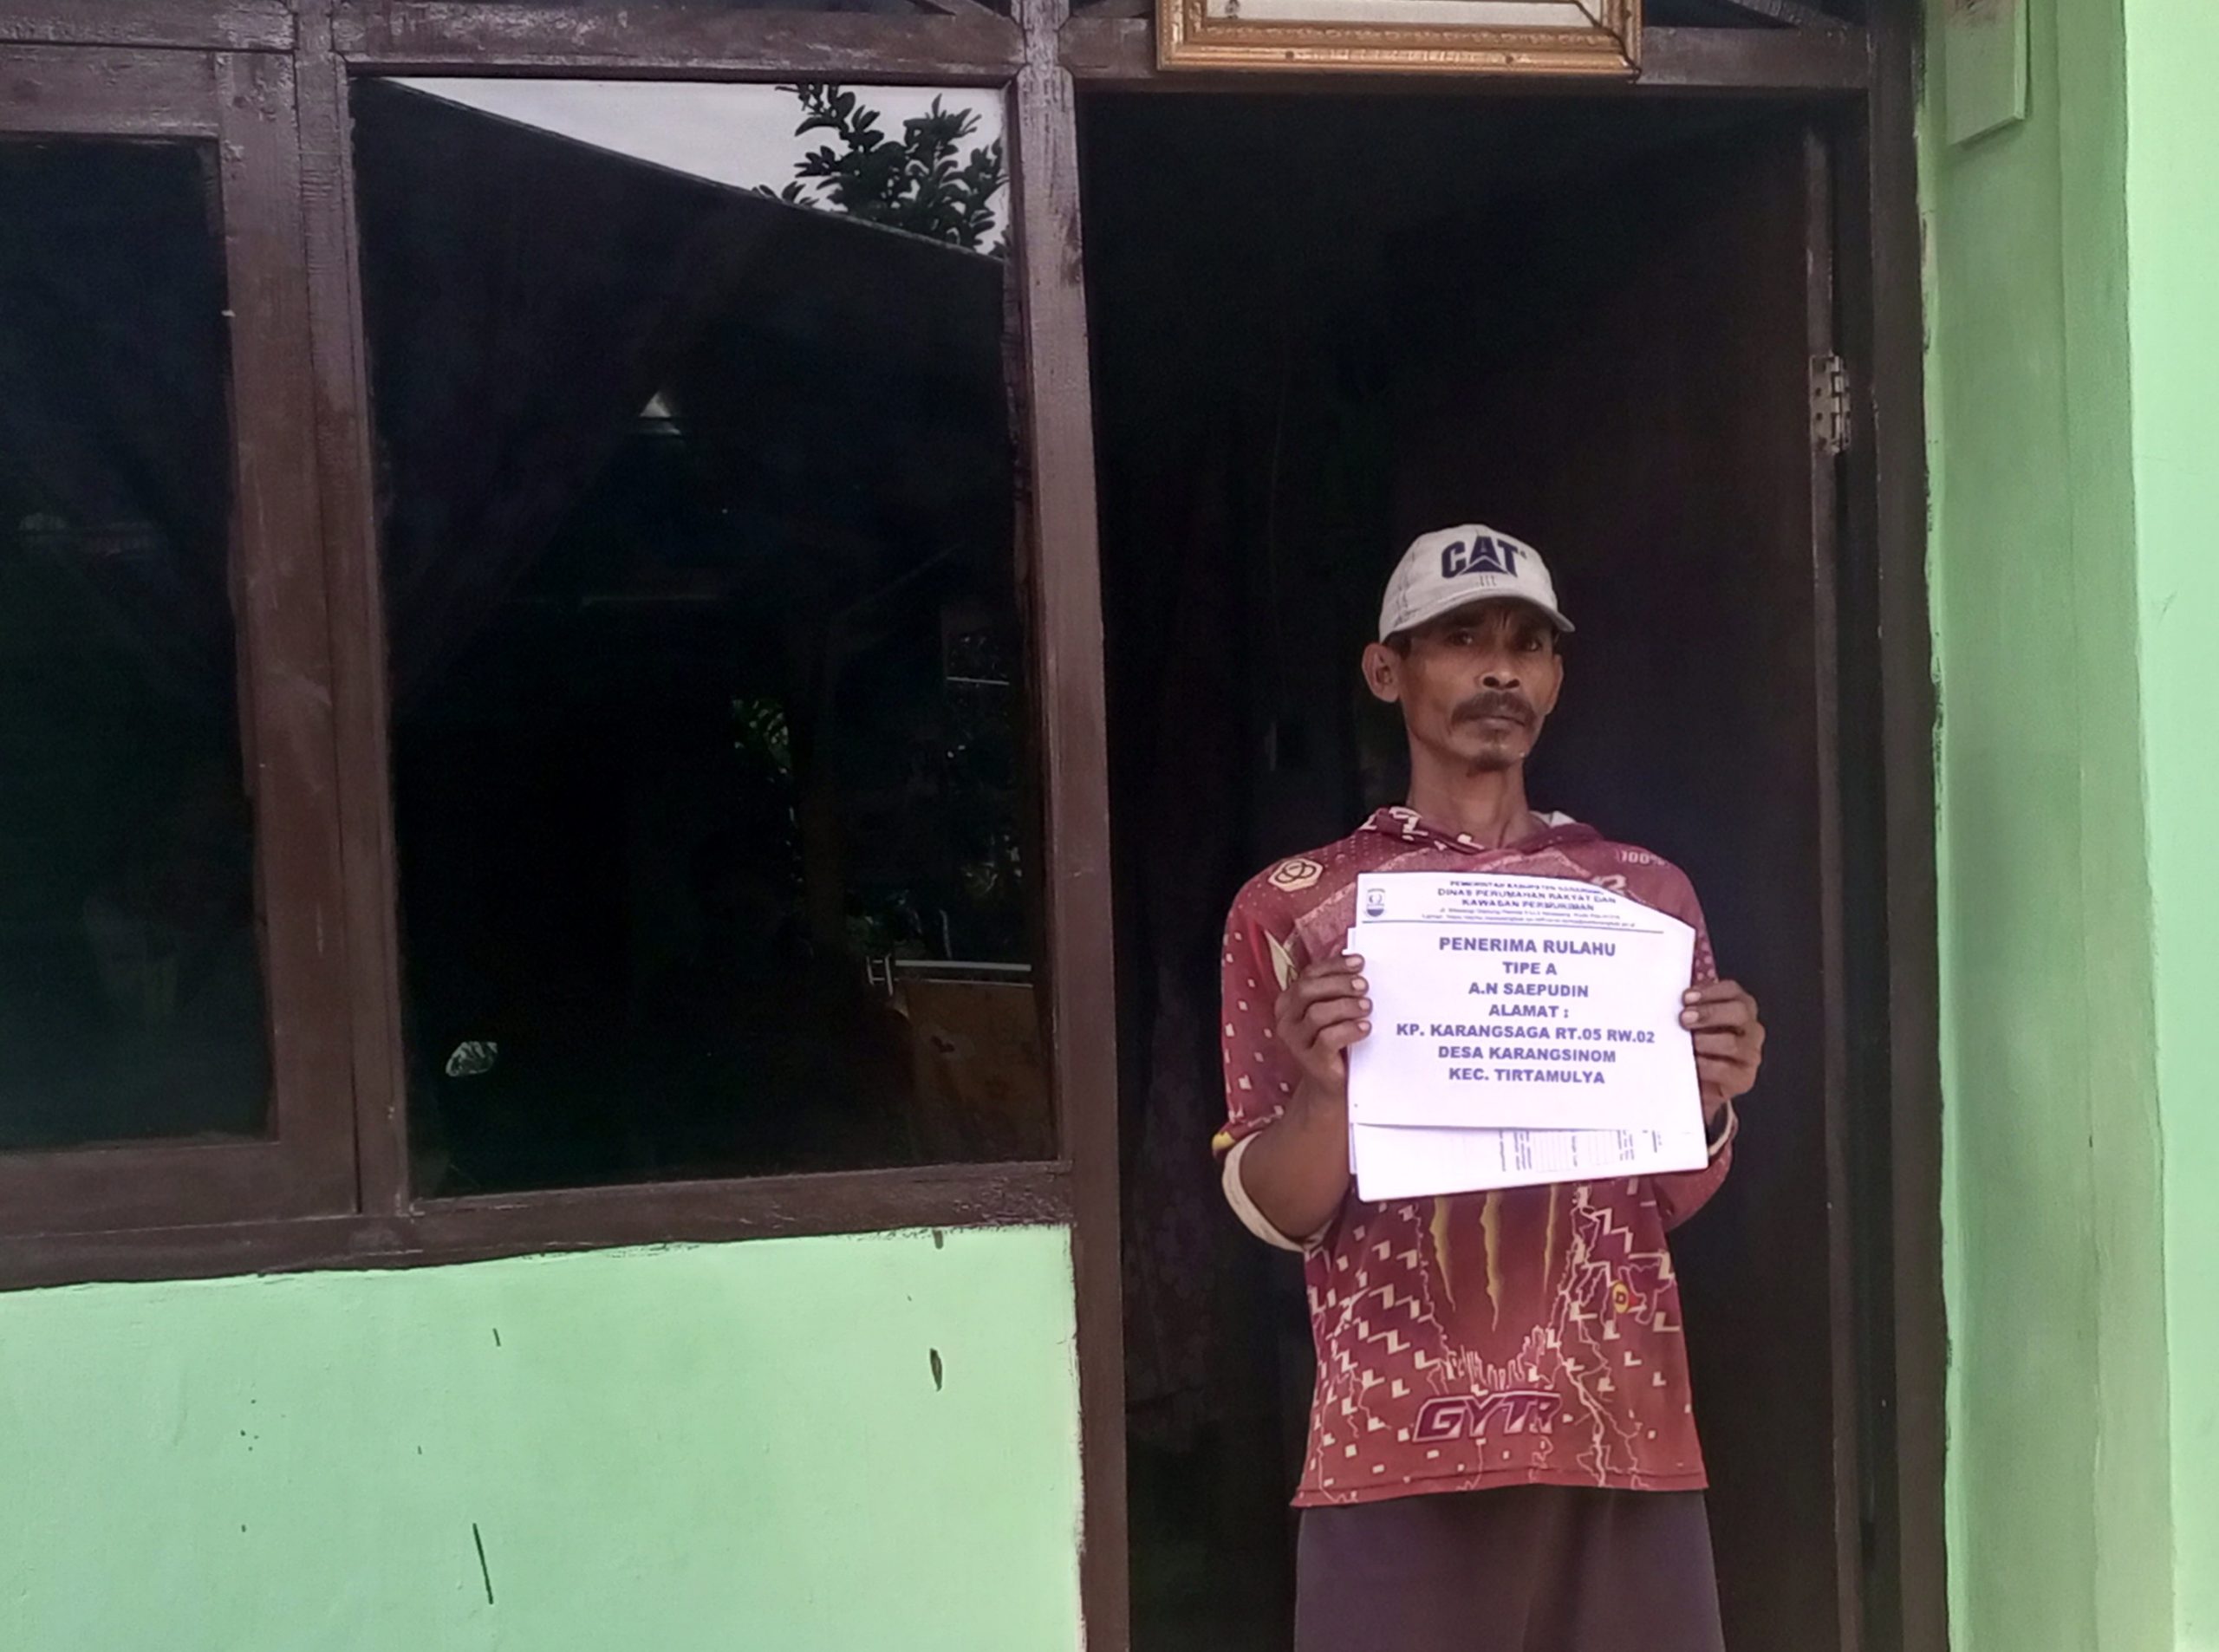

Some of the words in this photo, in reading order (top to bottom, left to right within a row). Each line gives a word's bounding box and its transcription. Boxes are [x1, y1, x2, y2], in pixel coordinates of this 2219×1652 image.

[1441, 536, 1519, 578] CAT
[1461, 899, 1519, 907] KAWASAN
[1475, 889, 1545, 899] PERUMAHAN
[1549, 893, 1591, 901] RAKYAT
[1440, 937, 1538, 953] PENERIMA
[1544, 940, 1616, 956] RULAHU
[1502, 961, 1541, 974] TIPE
[1545, 962, 1558, 975] A
[1468, 981, 1499, 995] A.N
[1503, 982, 1589, 998] SAEPUDIN
[1488, 1004, 1559, 1018] ALAMAT
[1396, 1023, 1424, 1037] KP.
[1429, 1024, 1550, 1039] KARANGSAGA
[1556, 1026, 1602, 1041] RT.05
[1606, 1028, 1655, 1044] RW.02
[1438, 1045, 1484, 1059] DESA
[1488, 1046, 1616, 1062] KARANGSINOM
[1448, 1067, 1489, 1081] KEC.
[1494, 1068, 1605, 1083] TIRTAMULYA
[1413, 1390, 1561, 1443] GYTR
